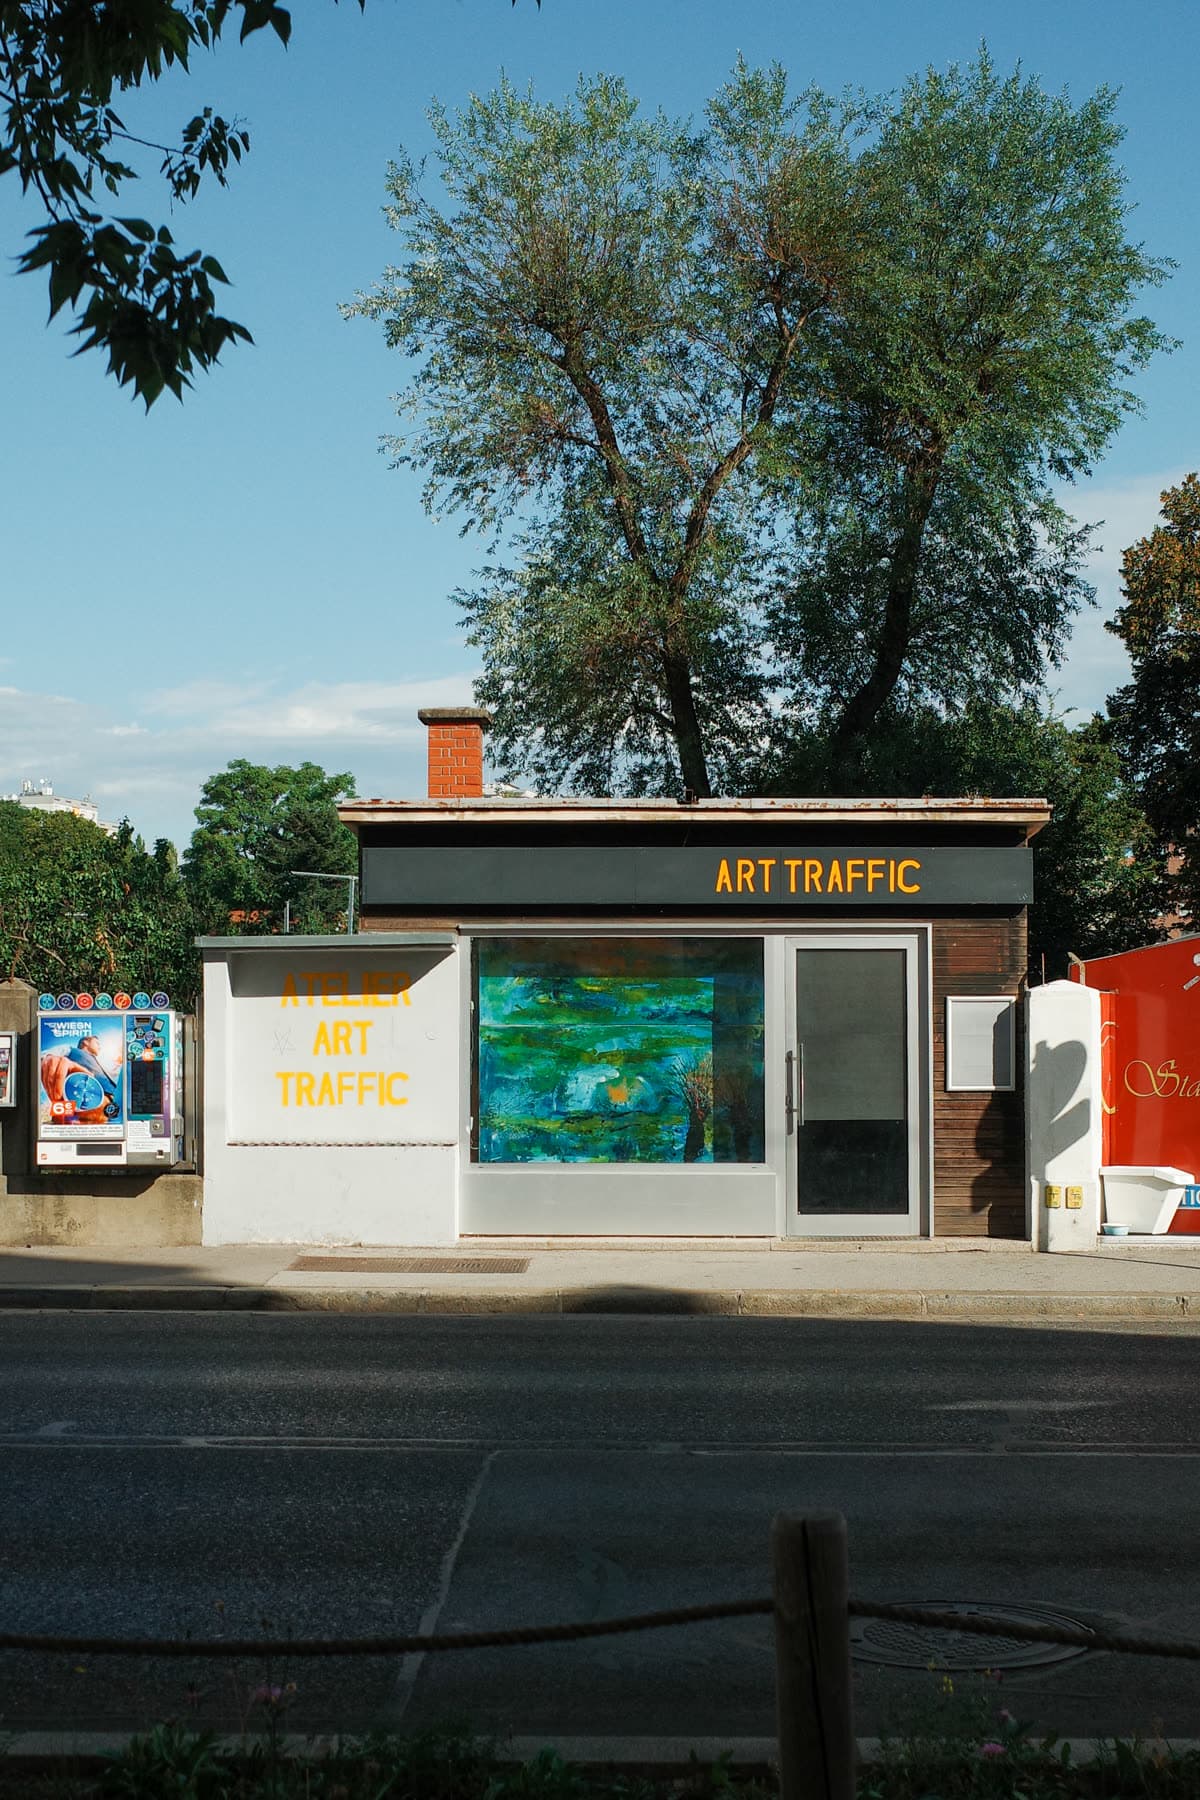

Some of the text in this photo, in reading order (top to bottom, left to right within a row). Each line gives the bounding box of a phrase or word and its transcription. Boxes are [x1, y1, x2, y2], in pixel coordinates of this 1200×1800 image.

[715, 859, 921, 893] ART TRAFFIC
[281, 972, 412, 1008] ATELIER
[313, 1020, 374, 1056] ART
[275, 1071, 409, 1107] TRAFFIC
